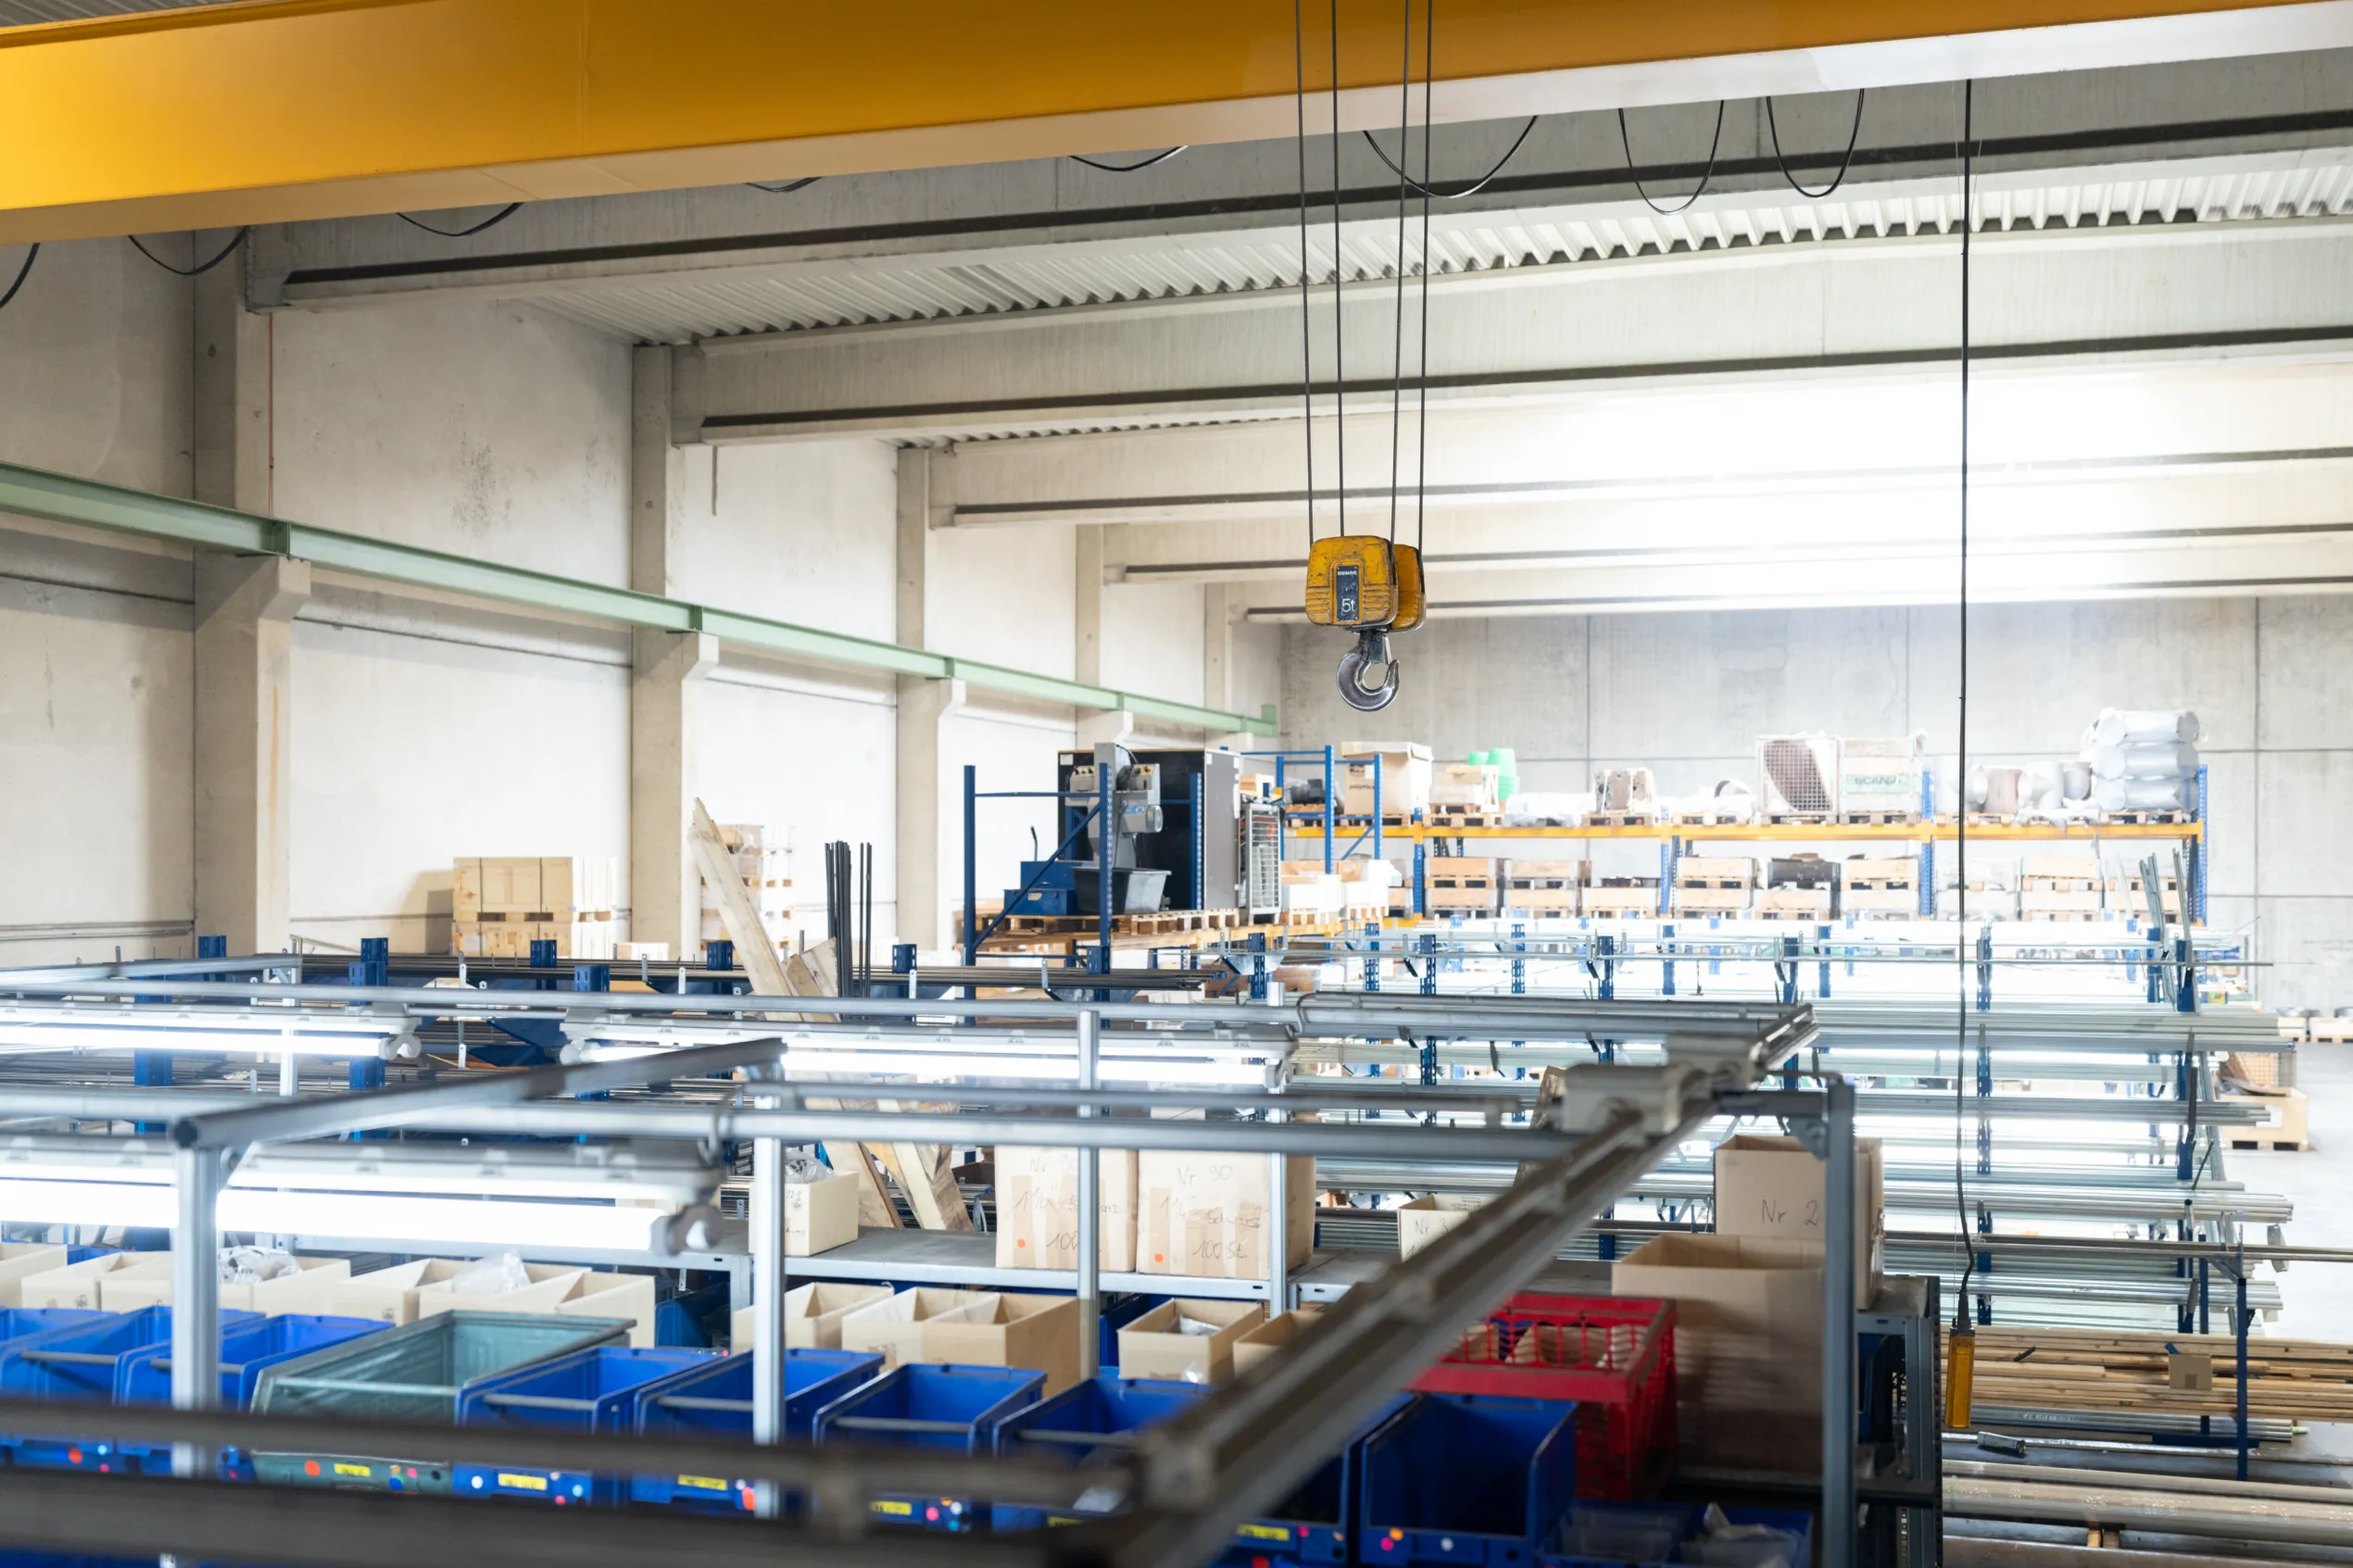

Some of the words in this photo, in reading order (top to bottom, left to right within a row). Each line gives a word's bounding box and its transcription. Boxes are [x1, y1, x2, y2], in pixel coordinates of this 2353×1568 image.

[1341, 598, 1355, 613] 5t
[1176, 1165, 1197, 1185] Nr
[1208, 1164, 1233, 1182] 90
[1191, 1239, 1223, 1260] 100
